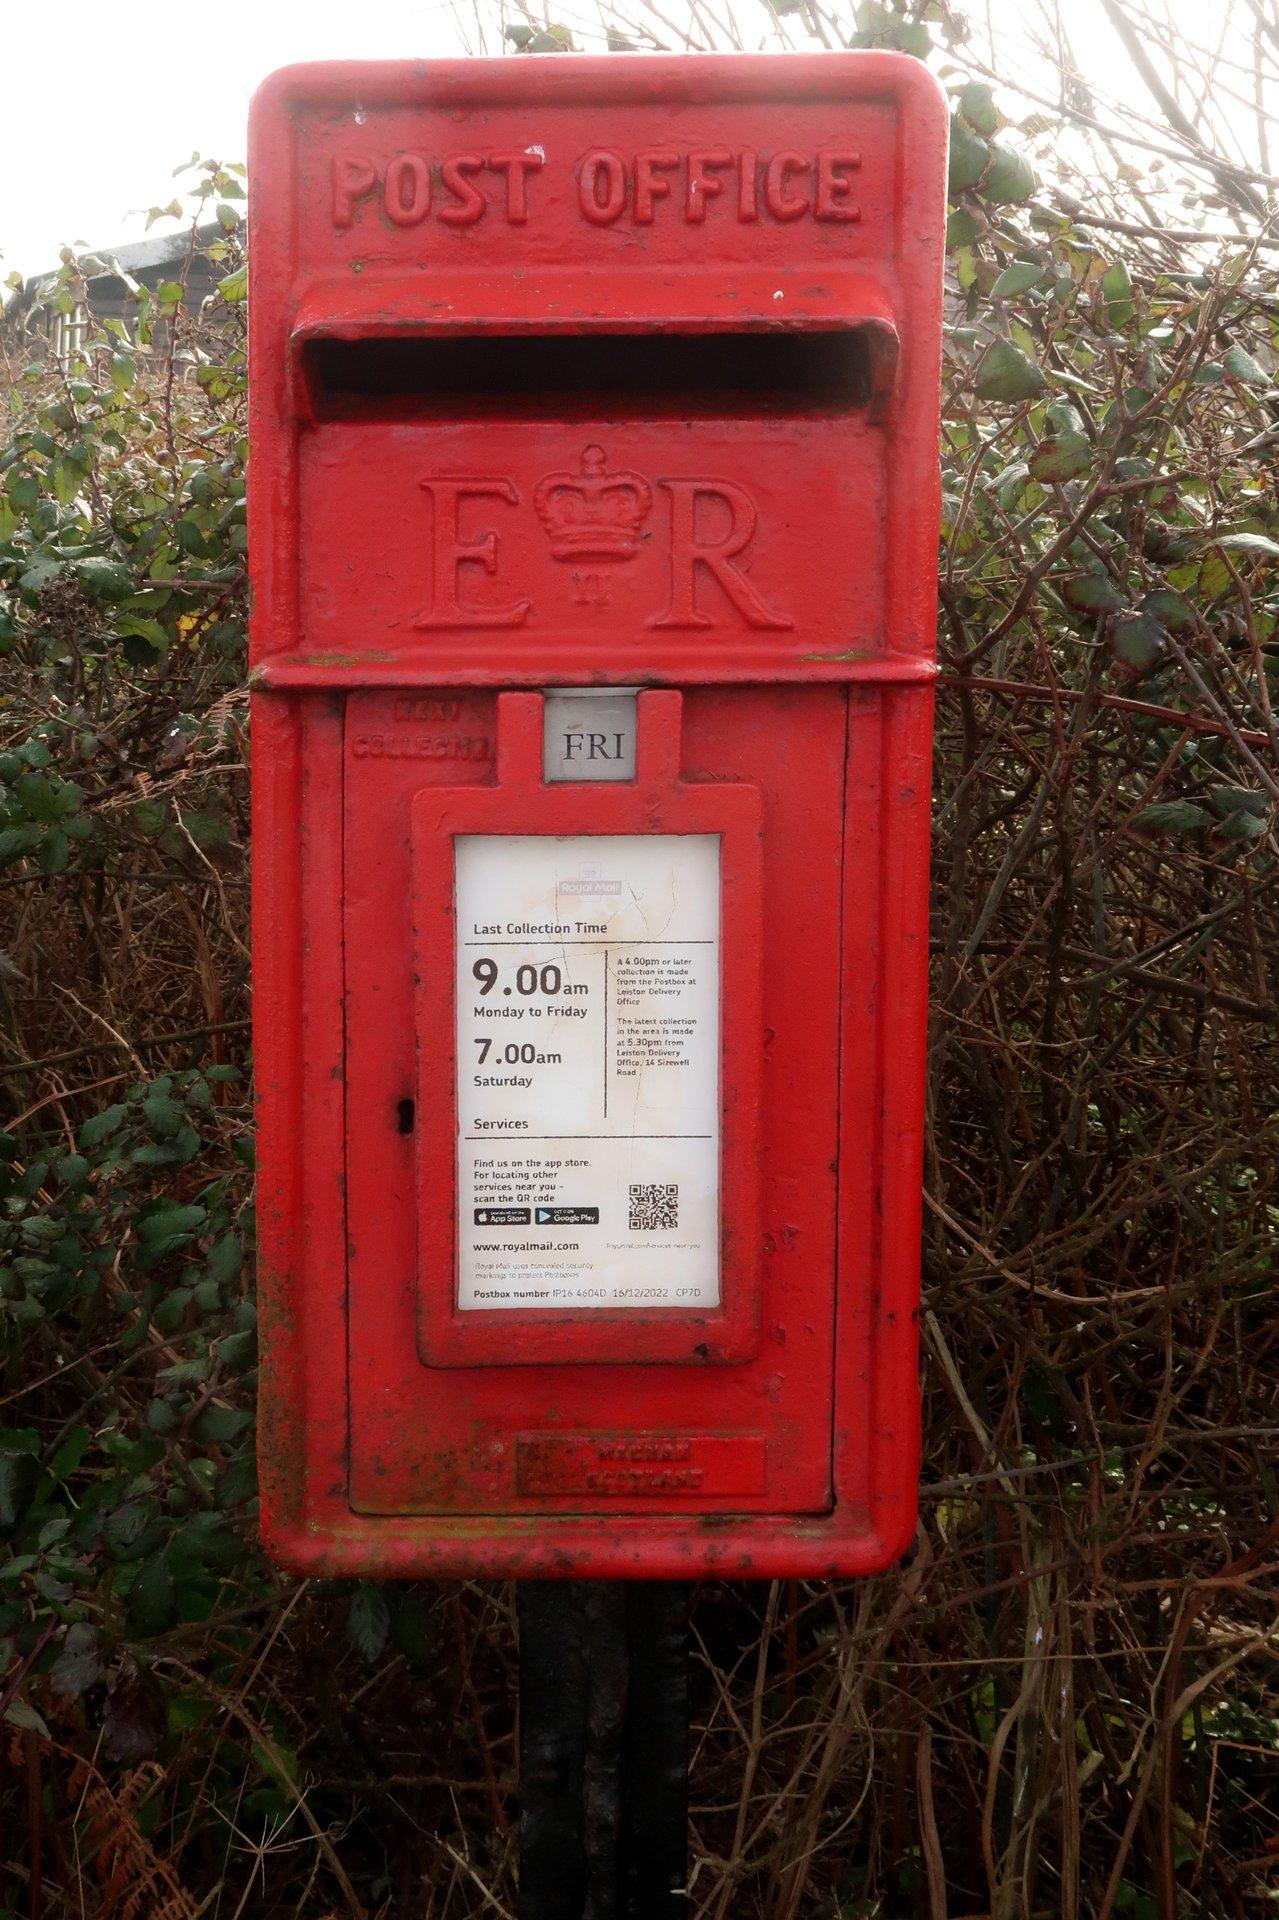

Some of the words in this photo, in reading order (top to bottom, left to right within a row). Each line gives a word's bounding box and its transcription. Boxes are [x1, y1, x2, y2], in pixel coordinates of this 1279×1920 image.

[330, 149, 543, 229] POST
[576, 148, 863, 227] OFFICE
[411, 475, 533, 630] E
[646, 475, 795, 630] R
[562, 732, 626, 761] FRI
[561, 882, 592, 894] Royal
[594, 882, 619, 892] Mail
[473, 922, 502, 935] Last
[506, 921, 571, 935] Collection
[575, 921, 608, 934] Time
[625, 957, 660, 967] 4.00pm
[472, 957, 589, 997] 9.00am
[617, 968, 655, 976] collection
[648, 988, 682, 996] Delivery
[473, 1005, 525, 1019] Monday
[528, 1006, 542, 1017] to
[547, 1005, 588, 1019] Friday
[617, 1017, 632, 1025] The
[634, 1017, 657, 1025] latest
[659, 1017, 697, 1025] collection
[617, 1027, 625, 1035] in
[627, 1027, 640, 1035] the
[662, 1027, 669, 1035] is
[672, 1027, 694, 1035] made
[627, 1038, 662, 1048] 5.30pm
[473, 1038, 562, 1065] 7.00am
[648, 1049, 681, 1057] Delivery
[657, 1058, 690, 1066] Sizewell
[473, 1075, 533, 1088] Saturday
[473, 1118, 529, 1130] Services
[473, 1159, 494, 1168] Find
[526, 1159, 541, 1167] the
[544, 1160, 562, 1168] app
[564, 1159, 593, 1167] store.
[473, 1171, 489, 1179] For
[492, 1171, 530, 1180] locating
[532, 1171, 558, 1179] other
[473, 1183, 512, 1191] services
[473, 1195, 495, 1203] scan
[498, 1194, 514, 1203] the
[516, 1193, 530, 1203] QR
[533, 1193, 555, 1202] code
[489, 1214, 506, 1223] App
[507, 1214, 527, 1222] Store
[553, 1213, 580, 1223] Google
[581, 1213, 596, 1223] Play
[473, 1241, 579, 1253] www.royalmail.com
[473, 1289, 510, 1299] Postbox
[513, 1289, 550, 1298] number
[552, 1288, 574, 1298] IP16
[612, 1288, 669, 1299] 16/12/2022
[675, 1287, 702, 1298] CP7D
